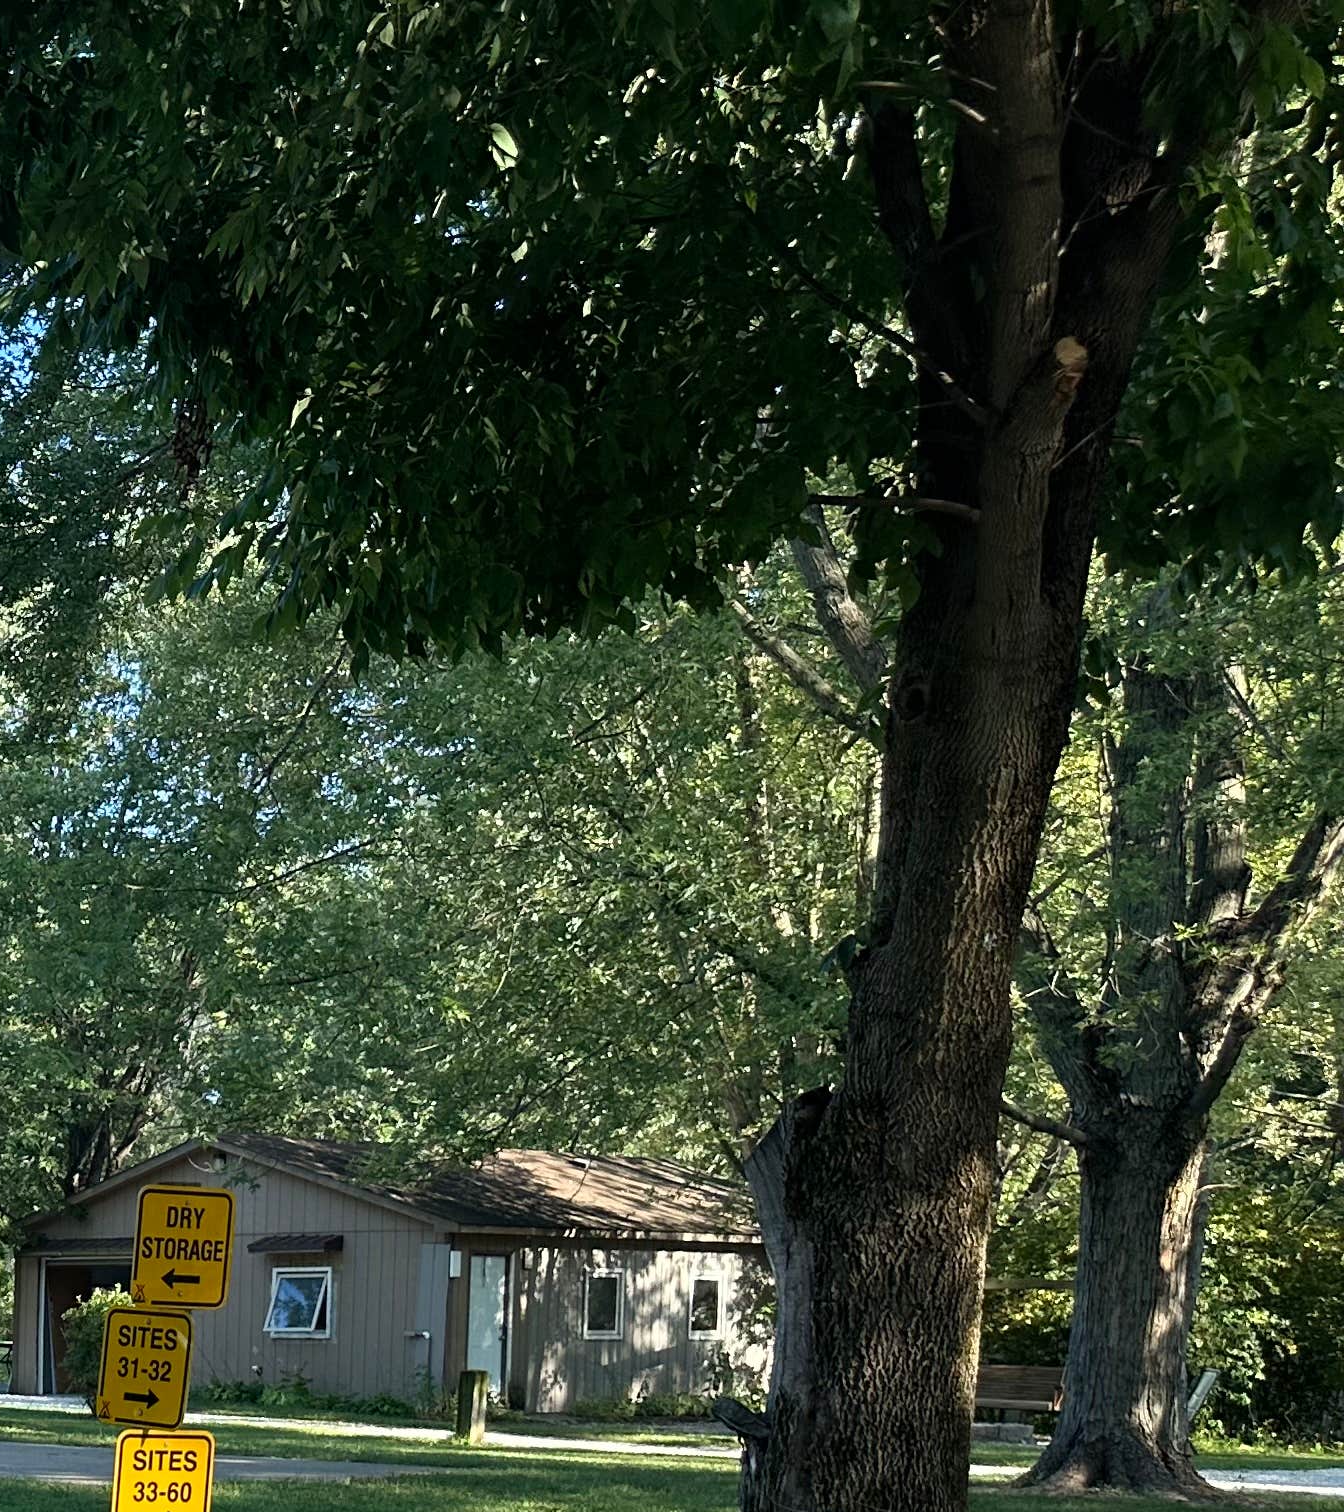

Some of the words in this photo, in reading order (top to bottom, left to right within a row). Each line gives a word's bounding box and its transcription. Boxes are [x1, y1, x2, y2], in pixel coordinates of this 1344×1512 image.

[166, 1206, 205, 1229] DRY
[141, 1236, 224, 1262] STORAGE
[118, 1325, 178, 1351] SITES
[117, 1357, 172, 1382] 31-32
[132, 1449, 198, 1472] SITES
[132, 1482, 192, 1503] 33-60
